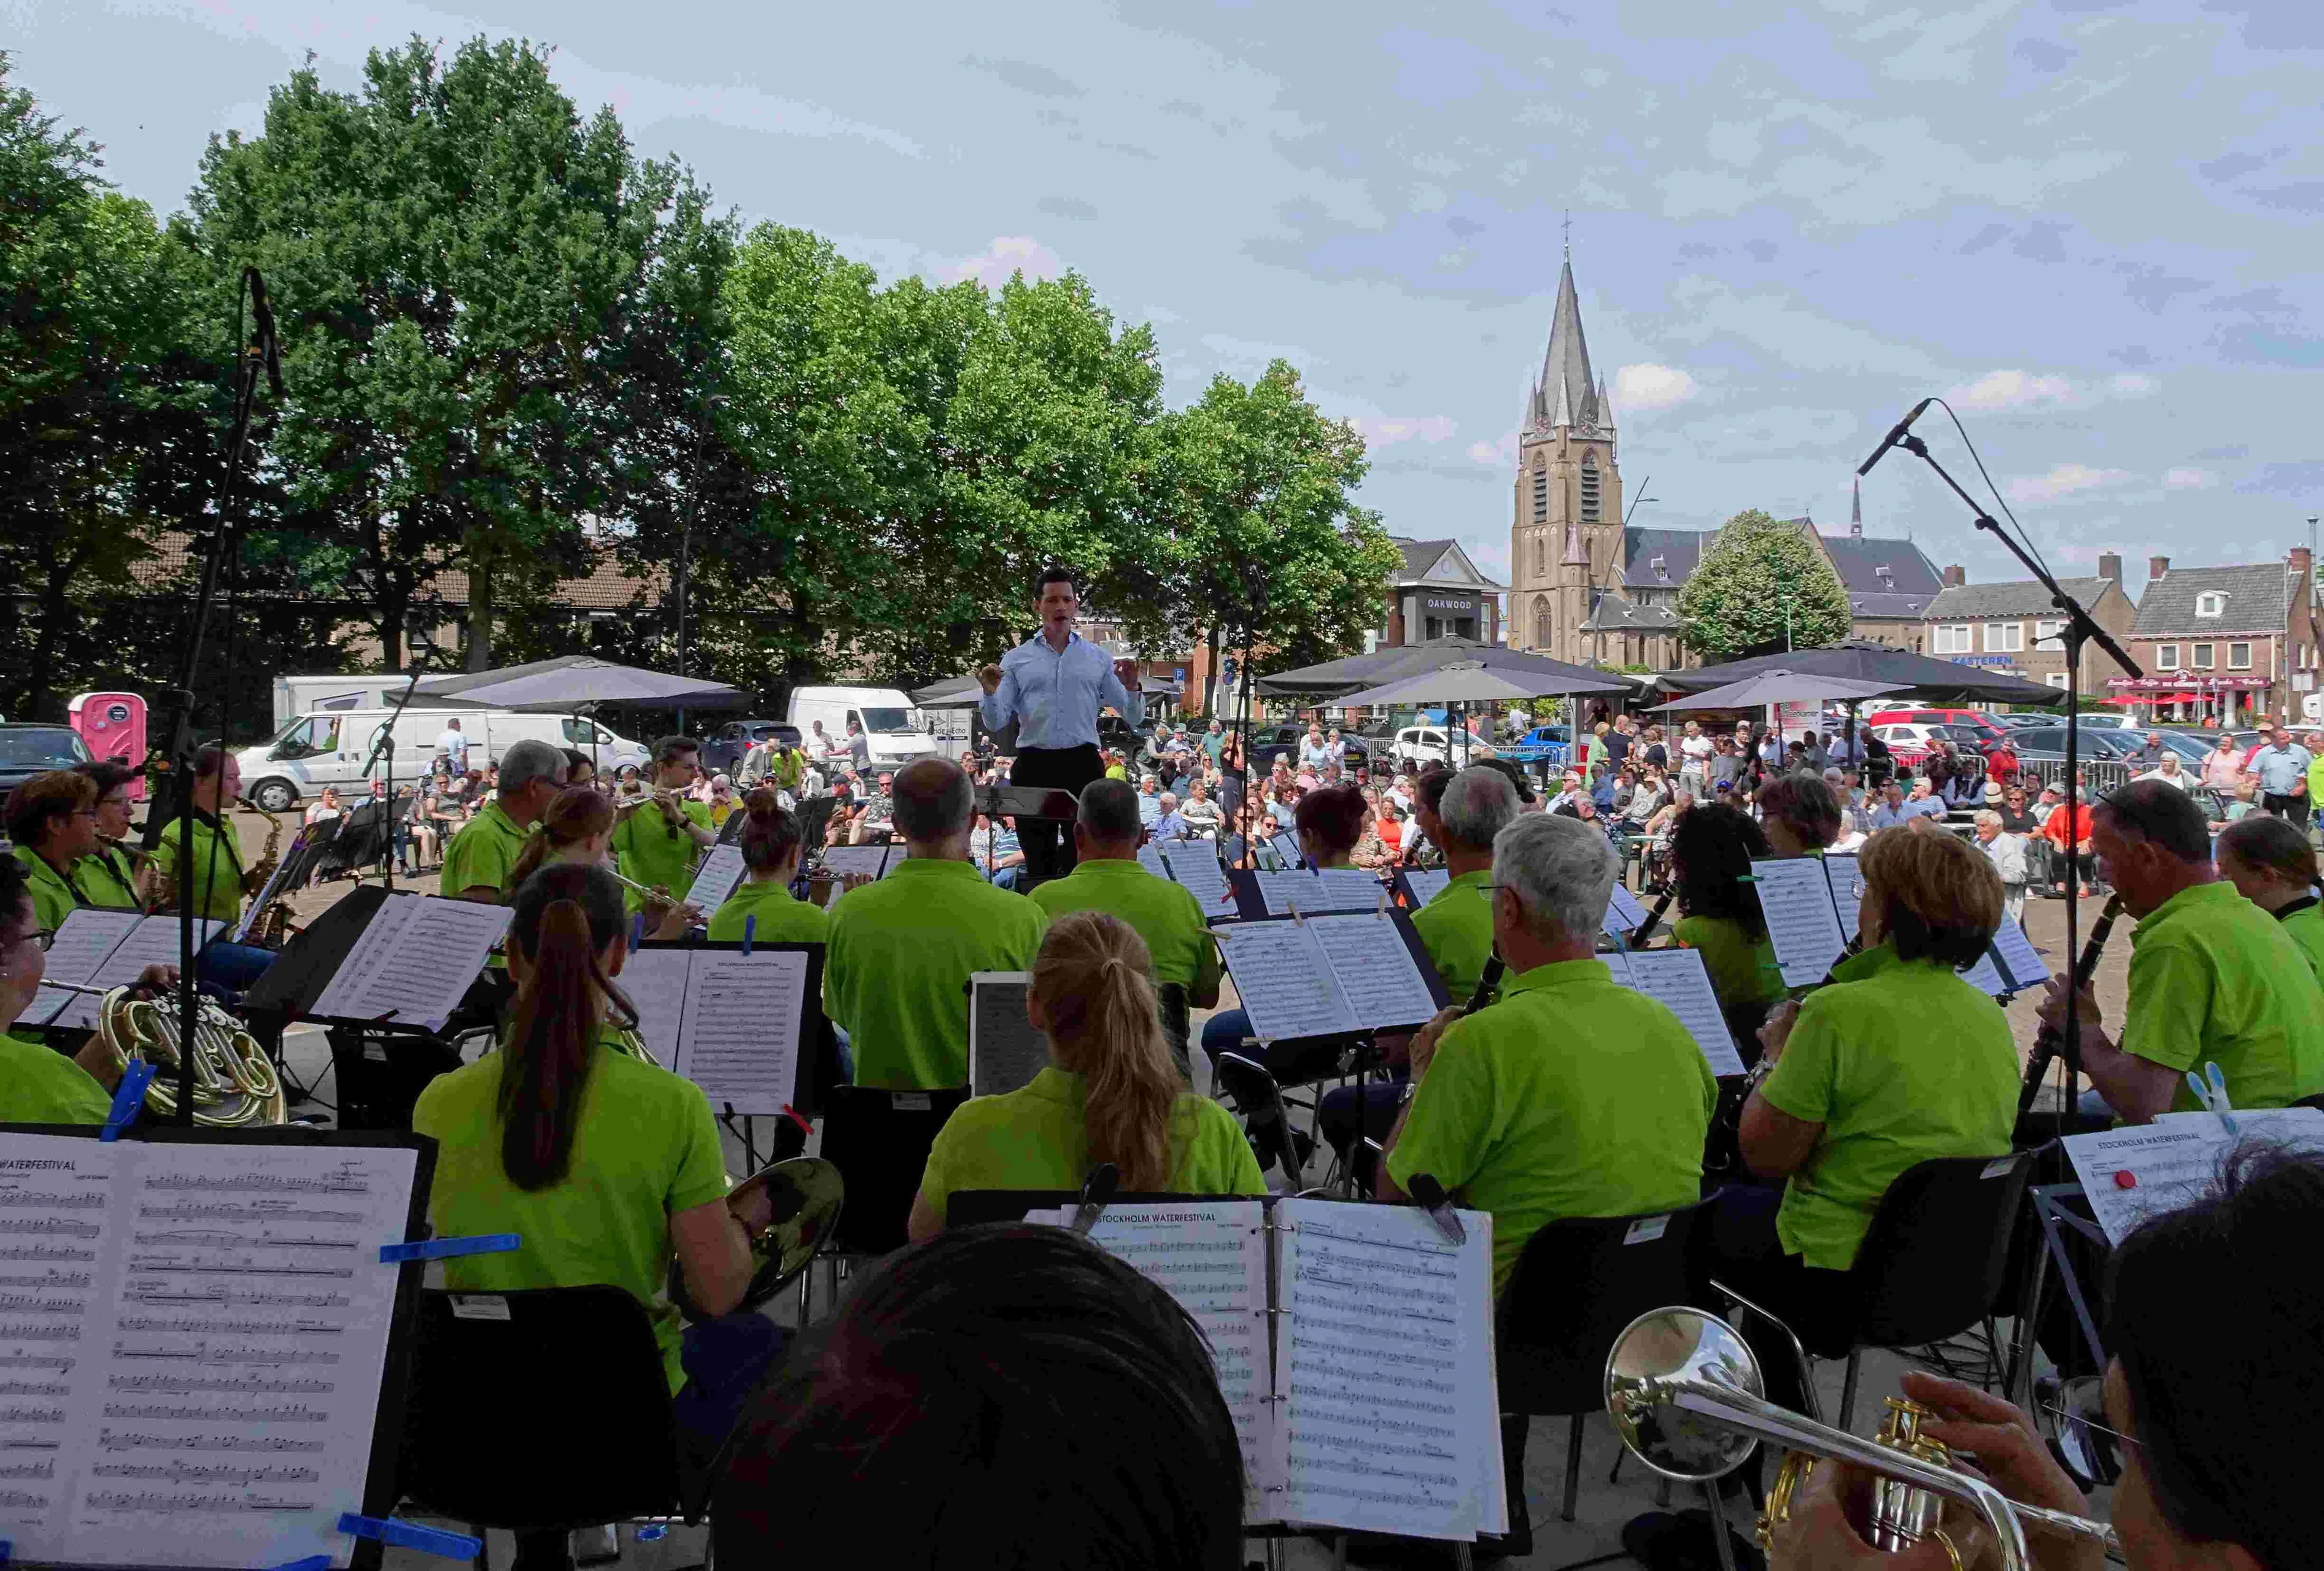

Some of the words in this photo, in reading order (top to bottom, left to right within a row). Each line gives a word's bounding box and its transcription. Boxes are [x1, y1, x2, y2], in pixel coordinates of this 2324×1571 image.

[1428, 599, 1471, 609] OAKWOOD
[1951, 656, 2012, 665] KASTEREN
[1177, 670, 1182, 679] P
[2097, 1138, 2144, 1149] STOCKHOLM
[1098, 1214, 1150, 1223] STOCKHOLM
[1153, 1213, 1216, 1222] WATERFESTIVAL
